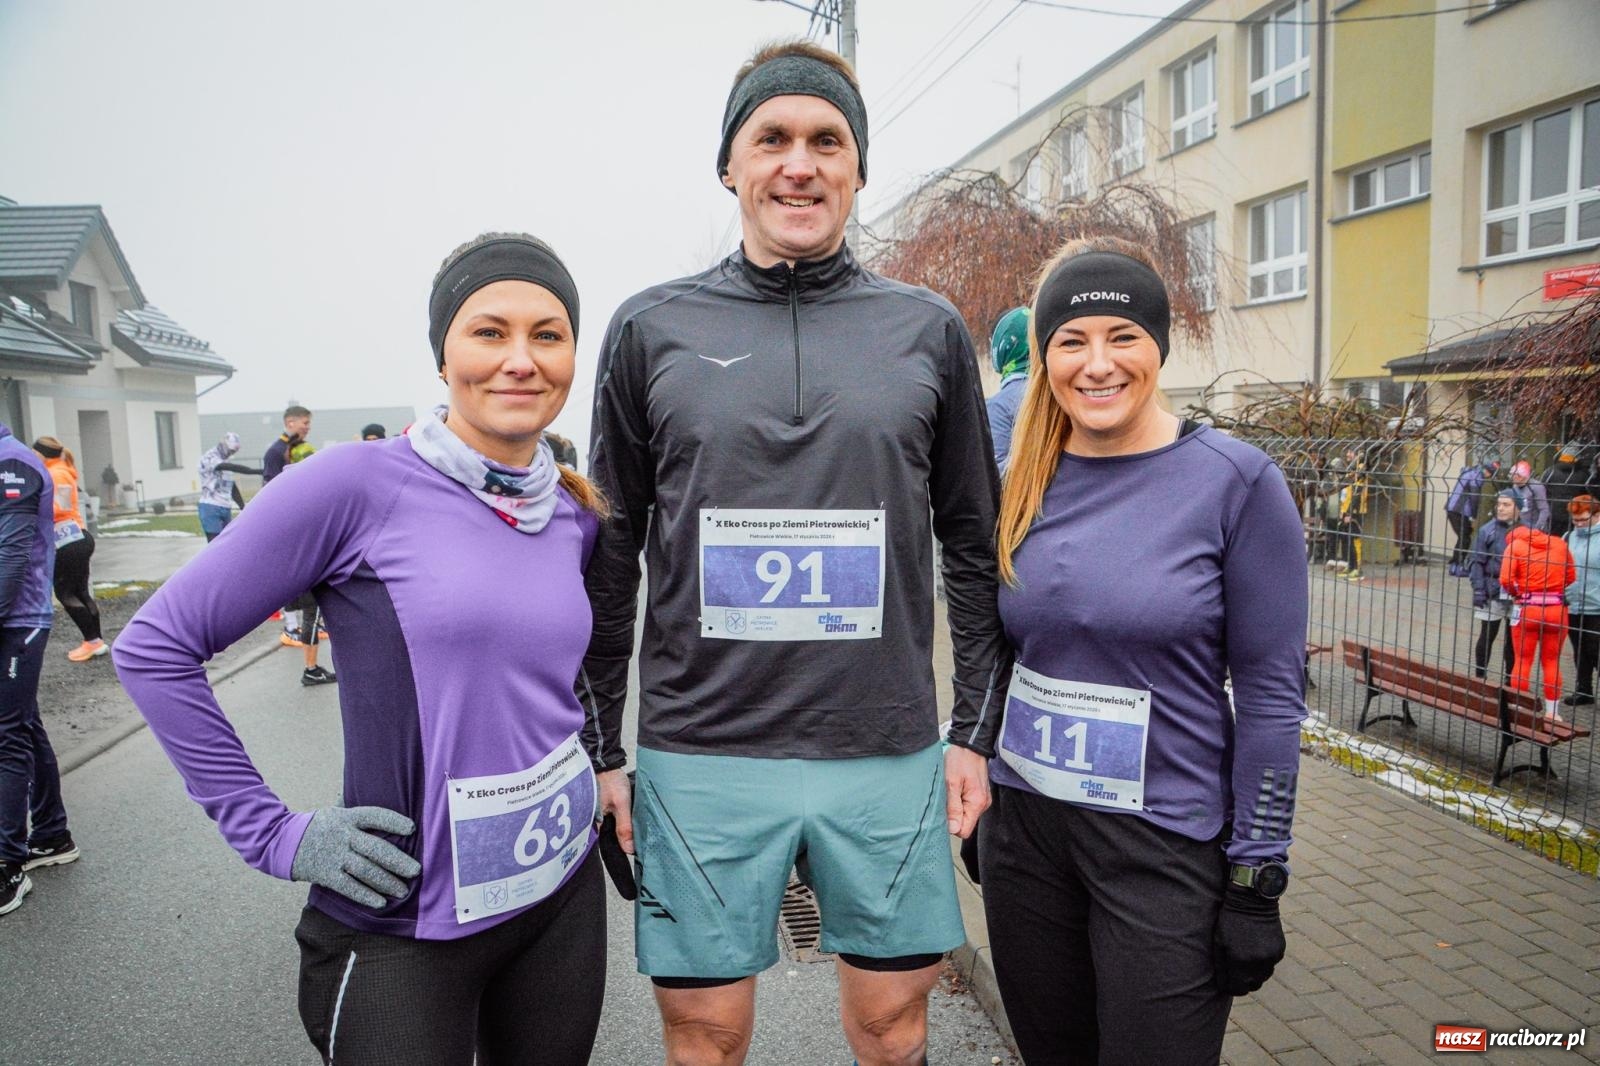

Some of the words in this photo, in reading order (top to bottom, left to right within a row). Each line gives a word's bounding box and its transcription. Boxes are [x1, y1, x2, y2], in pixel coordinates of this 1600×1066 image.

[1070, 291, 1131, 305] ATOMIC
[715, 520, 722, 528] X
[723, 520, 740, 528] Eko
[741, 520, 768, 528] Cross
[769, 522, 781, 530] po
[783, 520, 809, 529] Ziemi
[810, 520, 870, 530] Pietrowickiej
[755, 550, 831, 603] 91
[1030, 681, 1043, 693] Cross
[1043, 687, 1052, 696] po
[1053, 690, 1077, 699] Ziemi
[1078, 693, 1136, 709] Pietrowickiej
[1032, 715, 1093, 771] 11
[467, 791, 475, 799] X
[477, 788, 496, 798] Eko
[498, 784, 525, 795] Cross
[526, 779, 537, 791] po
[537, 767, 553, 784] Ziemi
[550, 746, 580, 774] Pietrowickiej
[513, 793, 572, 866] 63
